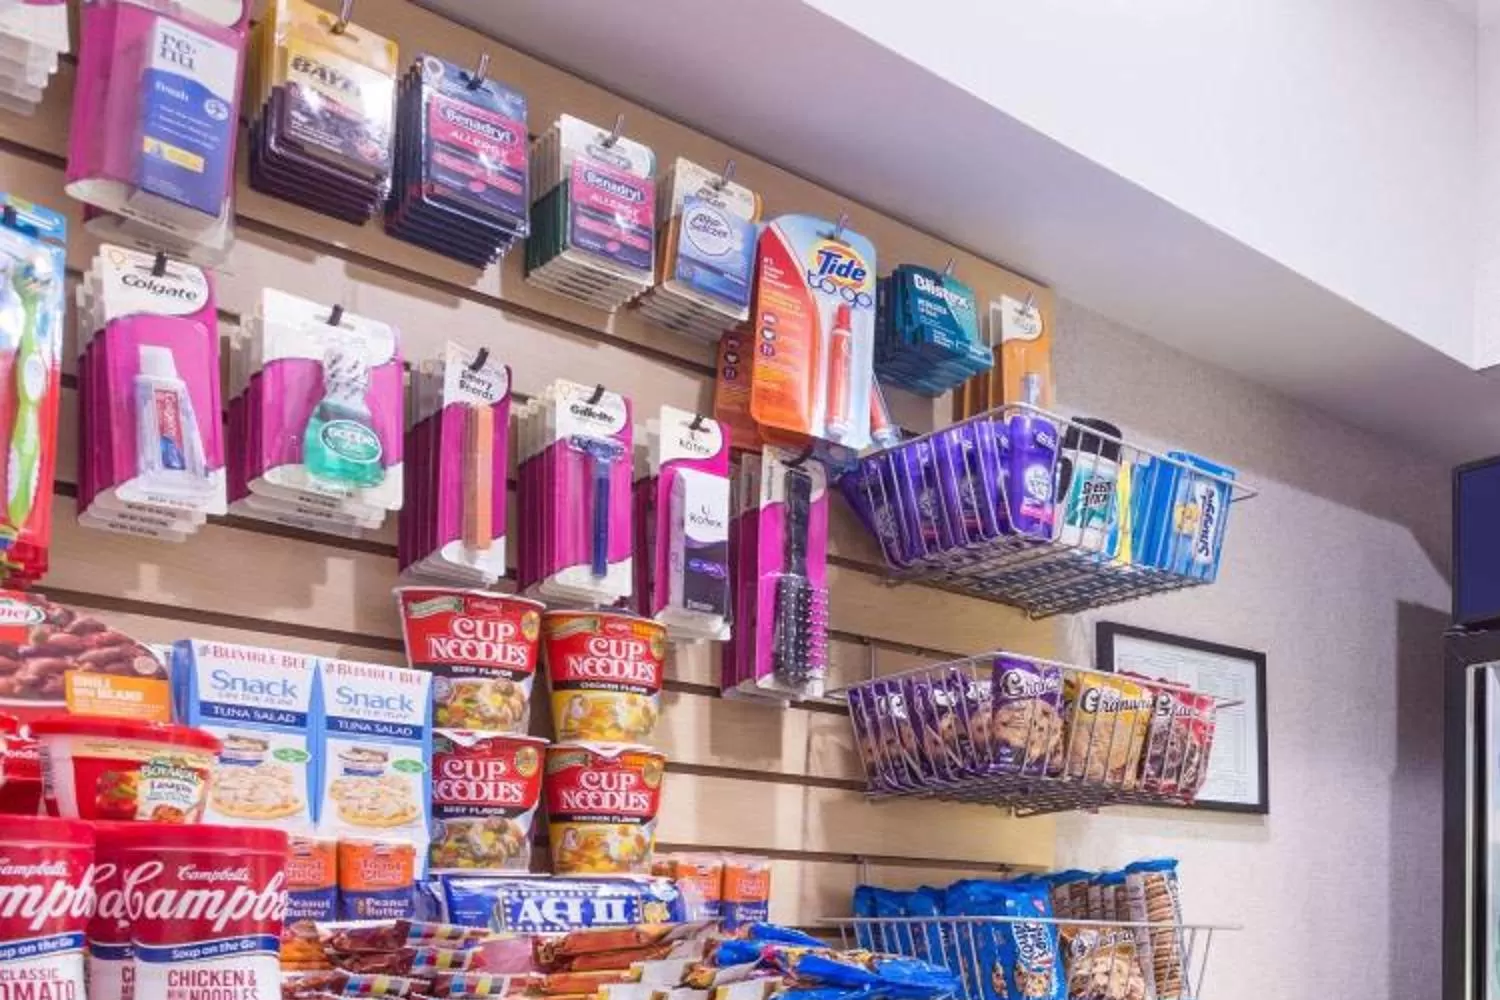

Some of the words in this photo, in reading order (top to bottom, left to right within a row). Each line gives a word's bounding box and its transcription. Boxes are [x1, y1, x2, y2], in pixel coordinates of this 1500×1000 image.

[817, 249, 867, 282] Tide
[121, 271, 198, 302] Colgate
[807, 269, 837, 295] to
[839, 285, 874, 309] go
[452, 618, 514, 641] CUP
[429, 637, 528, 667] NOODLES
[588, 638, 643, 660] CUP
[568, 655, 656, 682] NOODLES
[211, 669, 298, 699] Snack
[335, 685, 415, 713] Snack
[212, 706, 250, 718] TUNA
[253, 710, 296, 724] SALAD
[337, 719, 371, 731] TUNA
[374, 724, 413, 736] SALAD
[444, 759, 505, 782] CUP
[580, 771, 636, 793] CUP
[562, 788, 648, 814] NOODLES
[365, 897, 409, 908] Peanut
[365, 907, 406, 917] Butter
[172, 947, 200, 961] Soup
[201, 946, 218, 957] on
[220, 942, 238, 954] the
[0, 967, 60, 981] CLASSIC
[167, 969, 244, 987] CHICKEN
[247, 969, 257, 984] &
